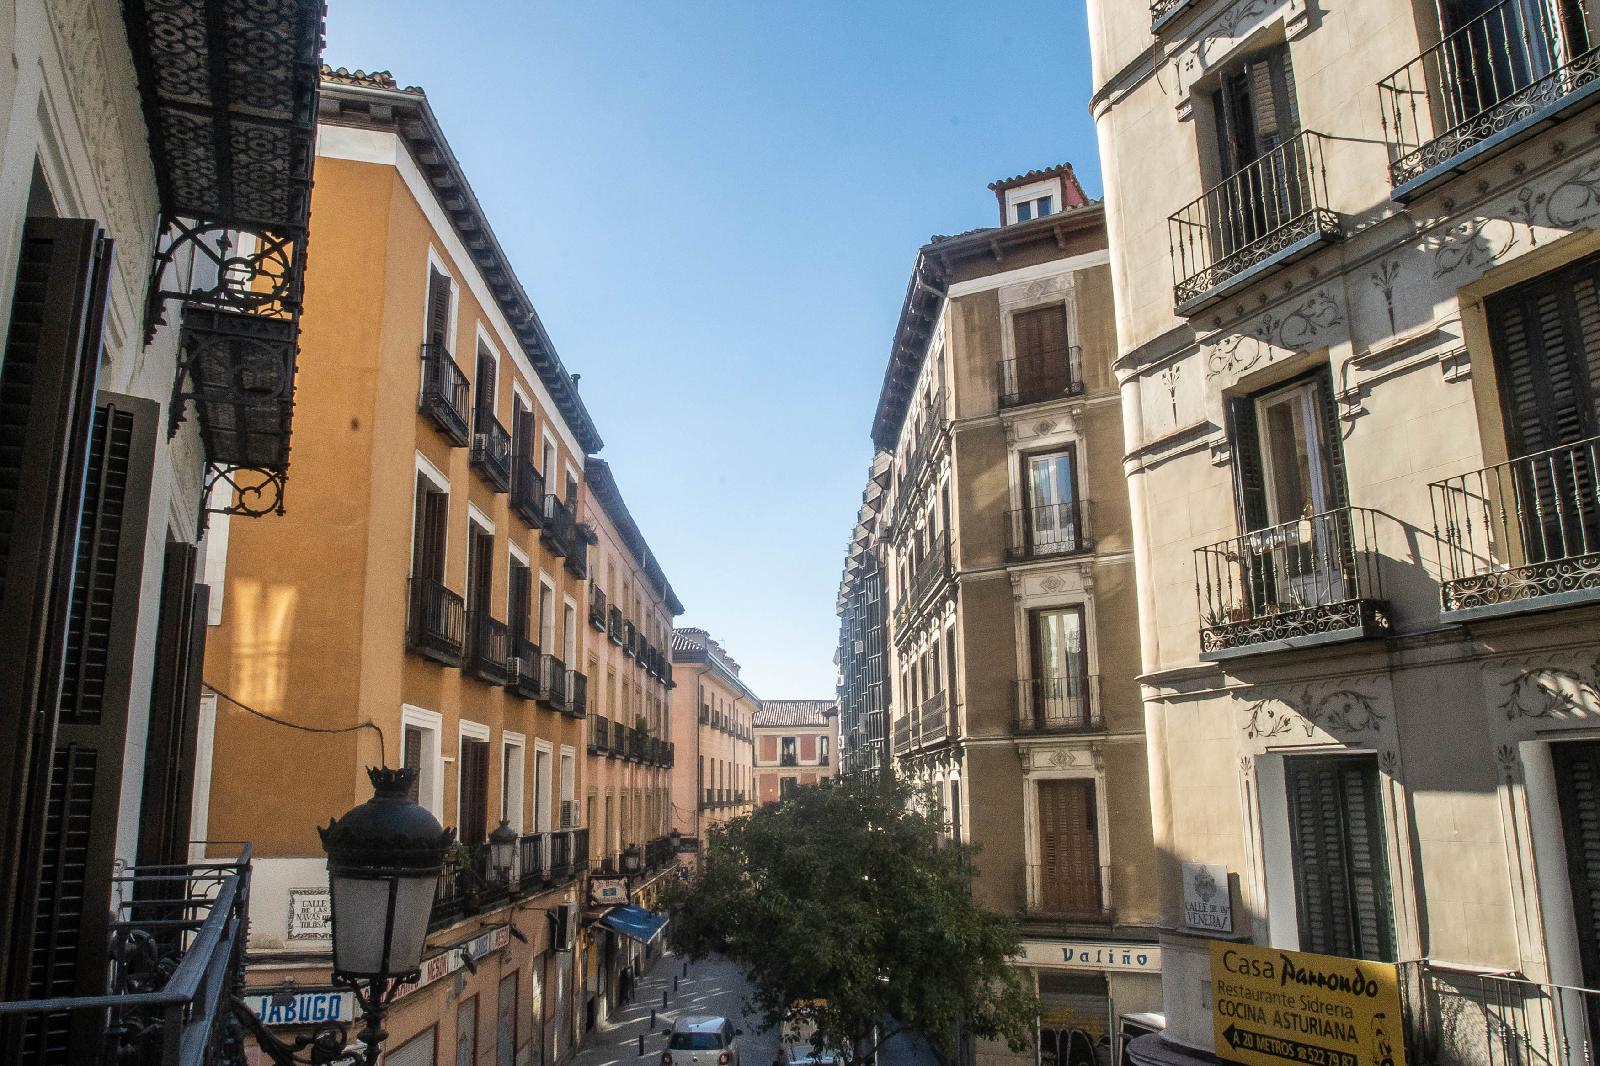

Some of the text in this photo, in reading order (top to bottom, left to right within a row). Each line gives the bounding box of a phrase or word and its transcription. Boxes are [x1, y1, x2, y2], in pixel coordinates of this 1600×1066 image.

[303, 900, 327, 908] CALLE
[1184, 901, 1208, 912] CALLE
[297, 913, 320, 921] NAVAS
[1186, 911, 1228, 929] VENERAS
[1062, 947, 1148, 966] Valiño
[1223, 950, 1378, 997] Casa Parrondo
[1218, 980, 1296, 1009] Restaurante
[256, 994, 342, 1023] JABUGO
[1218, 998, 1359, 1044] COCINA ASTURIANA
[1233, 1034, 1240, 1046] A
[1243, 1035, 1254, 1048] 20
[1257, 1038, 1295, 1057] METROS
[1308, 1048, 1325, 1064] 522
[1327, 1052, 1339, 1066] 79
